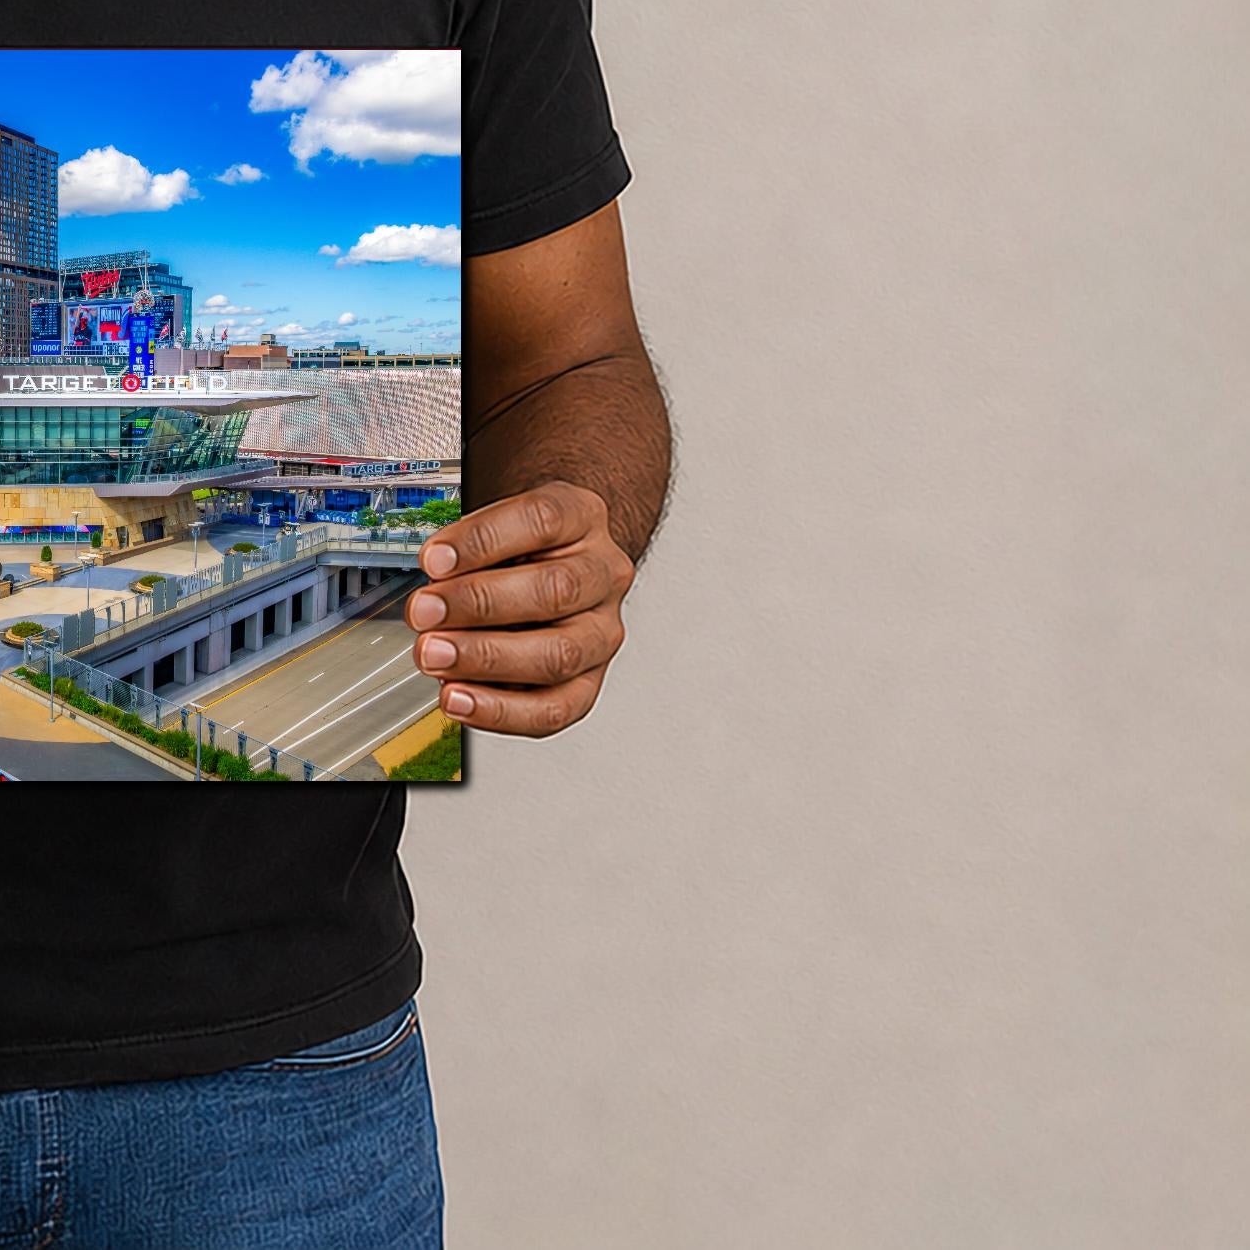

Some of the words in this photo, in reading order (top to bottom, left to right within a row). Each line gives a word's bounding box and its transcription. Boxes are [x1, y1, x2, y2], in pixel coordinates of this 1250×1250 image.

[2, 374, 120, 391] TARGET
[147, 374, 228, 391] FIELD
[351, 463, 397, 475] TARGET
[410, 461, 441, 471] FIELD
